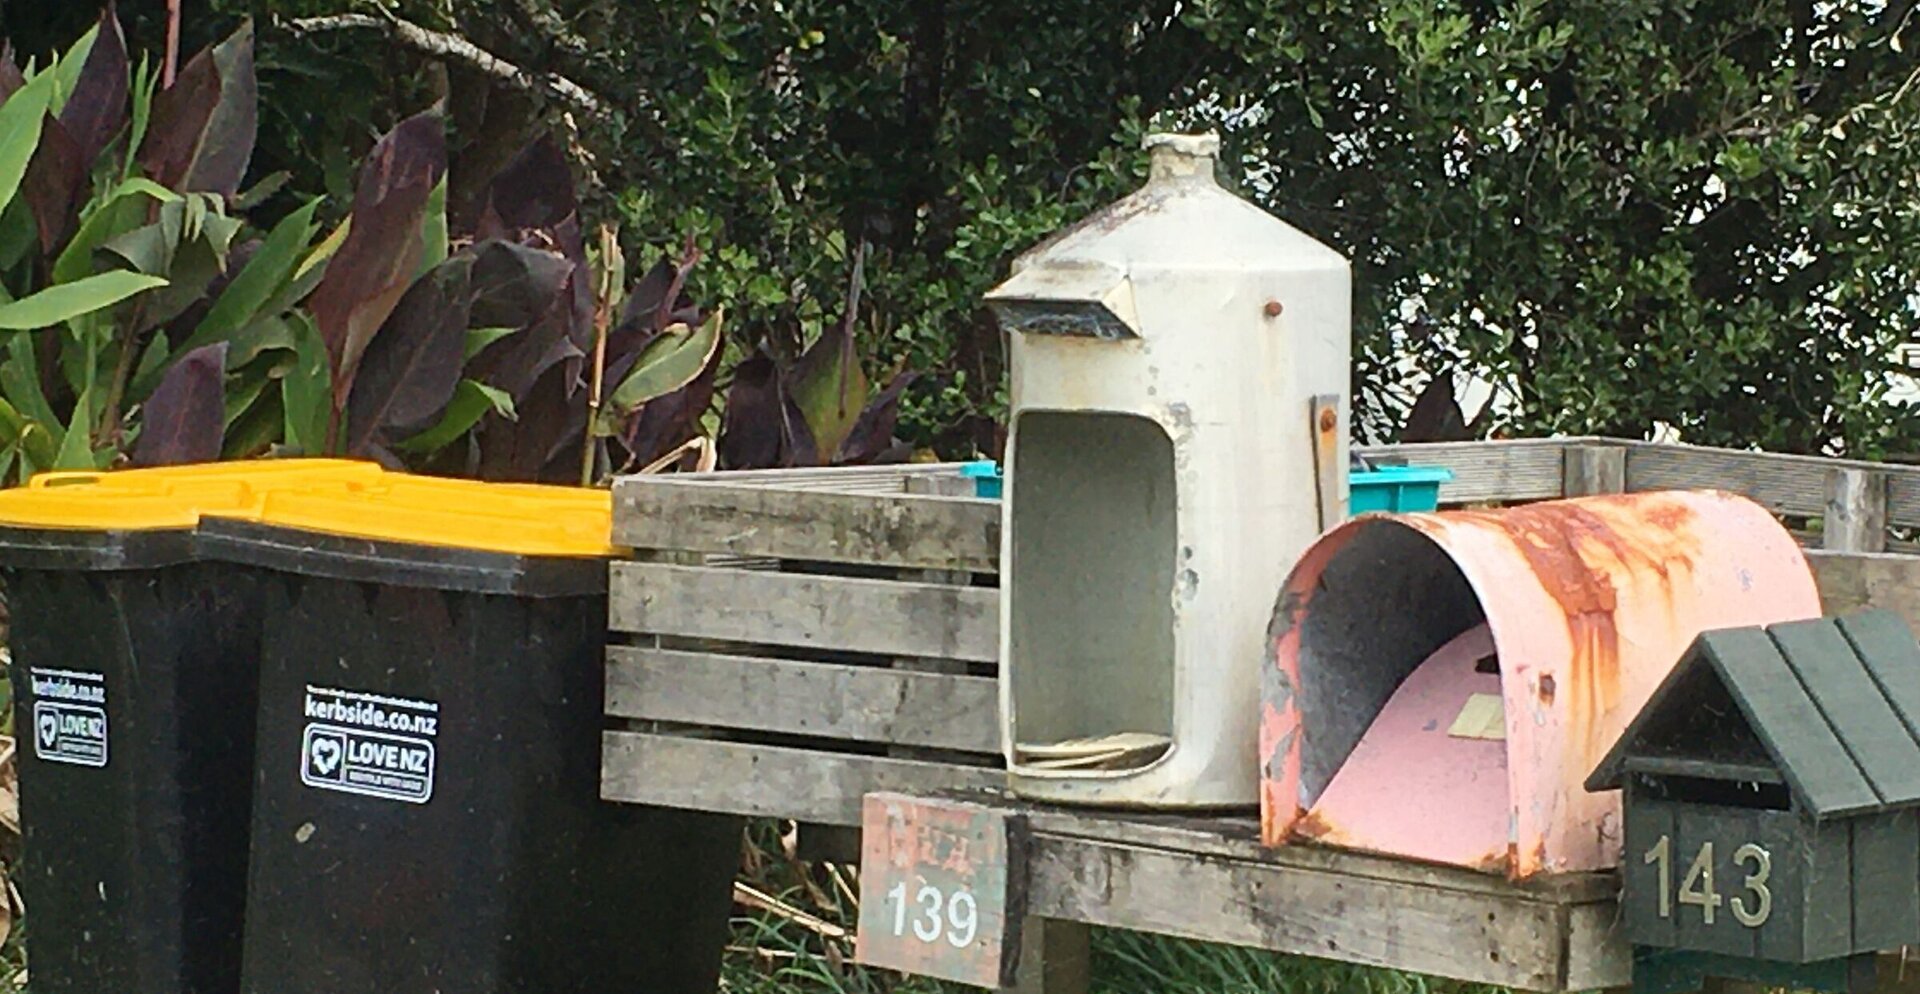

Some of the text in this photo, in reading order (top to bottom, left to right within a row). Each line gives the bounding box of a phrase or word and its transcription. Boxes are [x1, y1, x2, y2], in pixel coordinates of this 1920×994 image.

[304, 693, 437, 736] kerbside.co.nz
[887, 881, 978, 948] 139
[1644, 834, 1772, 928] 143
